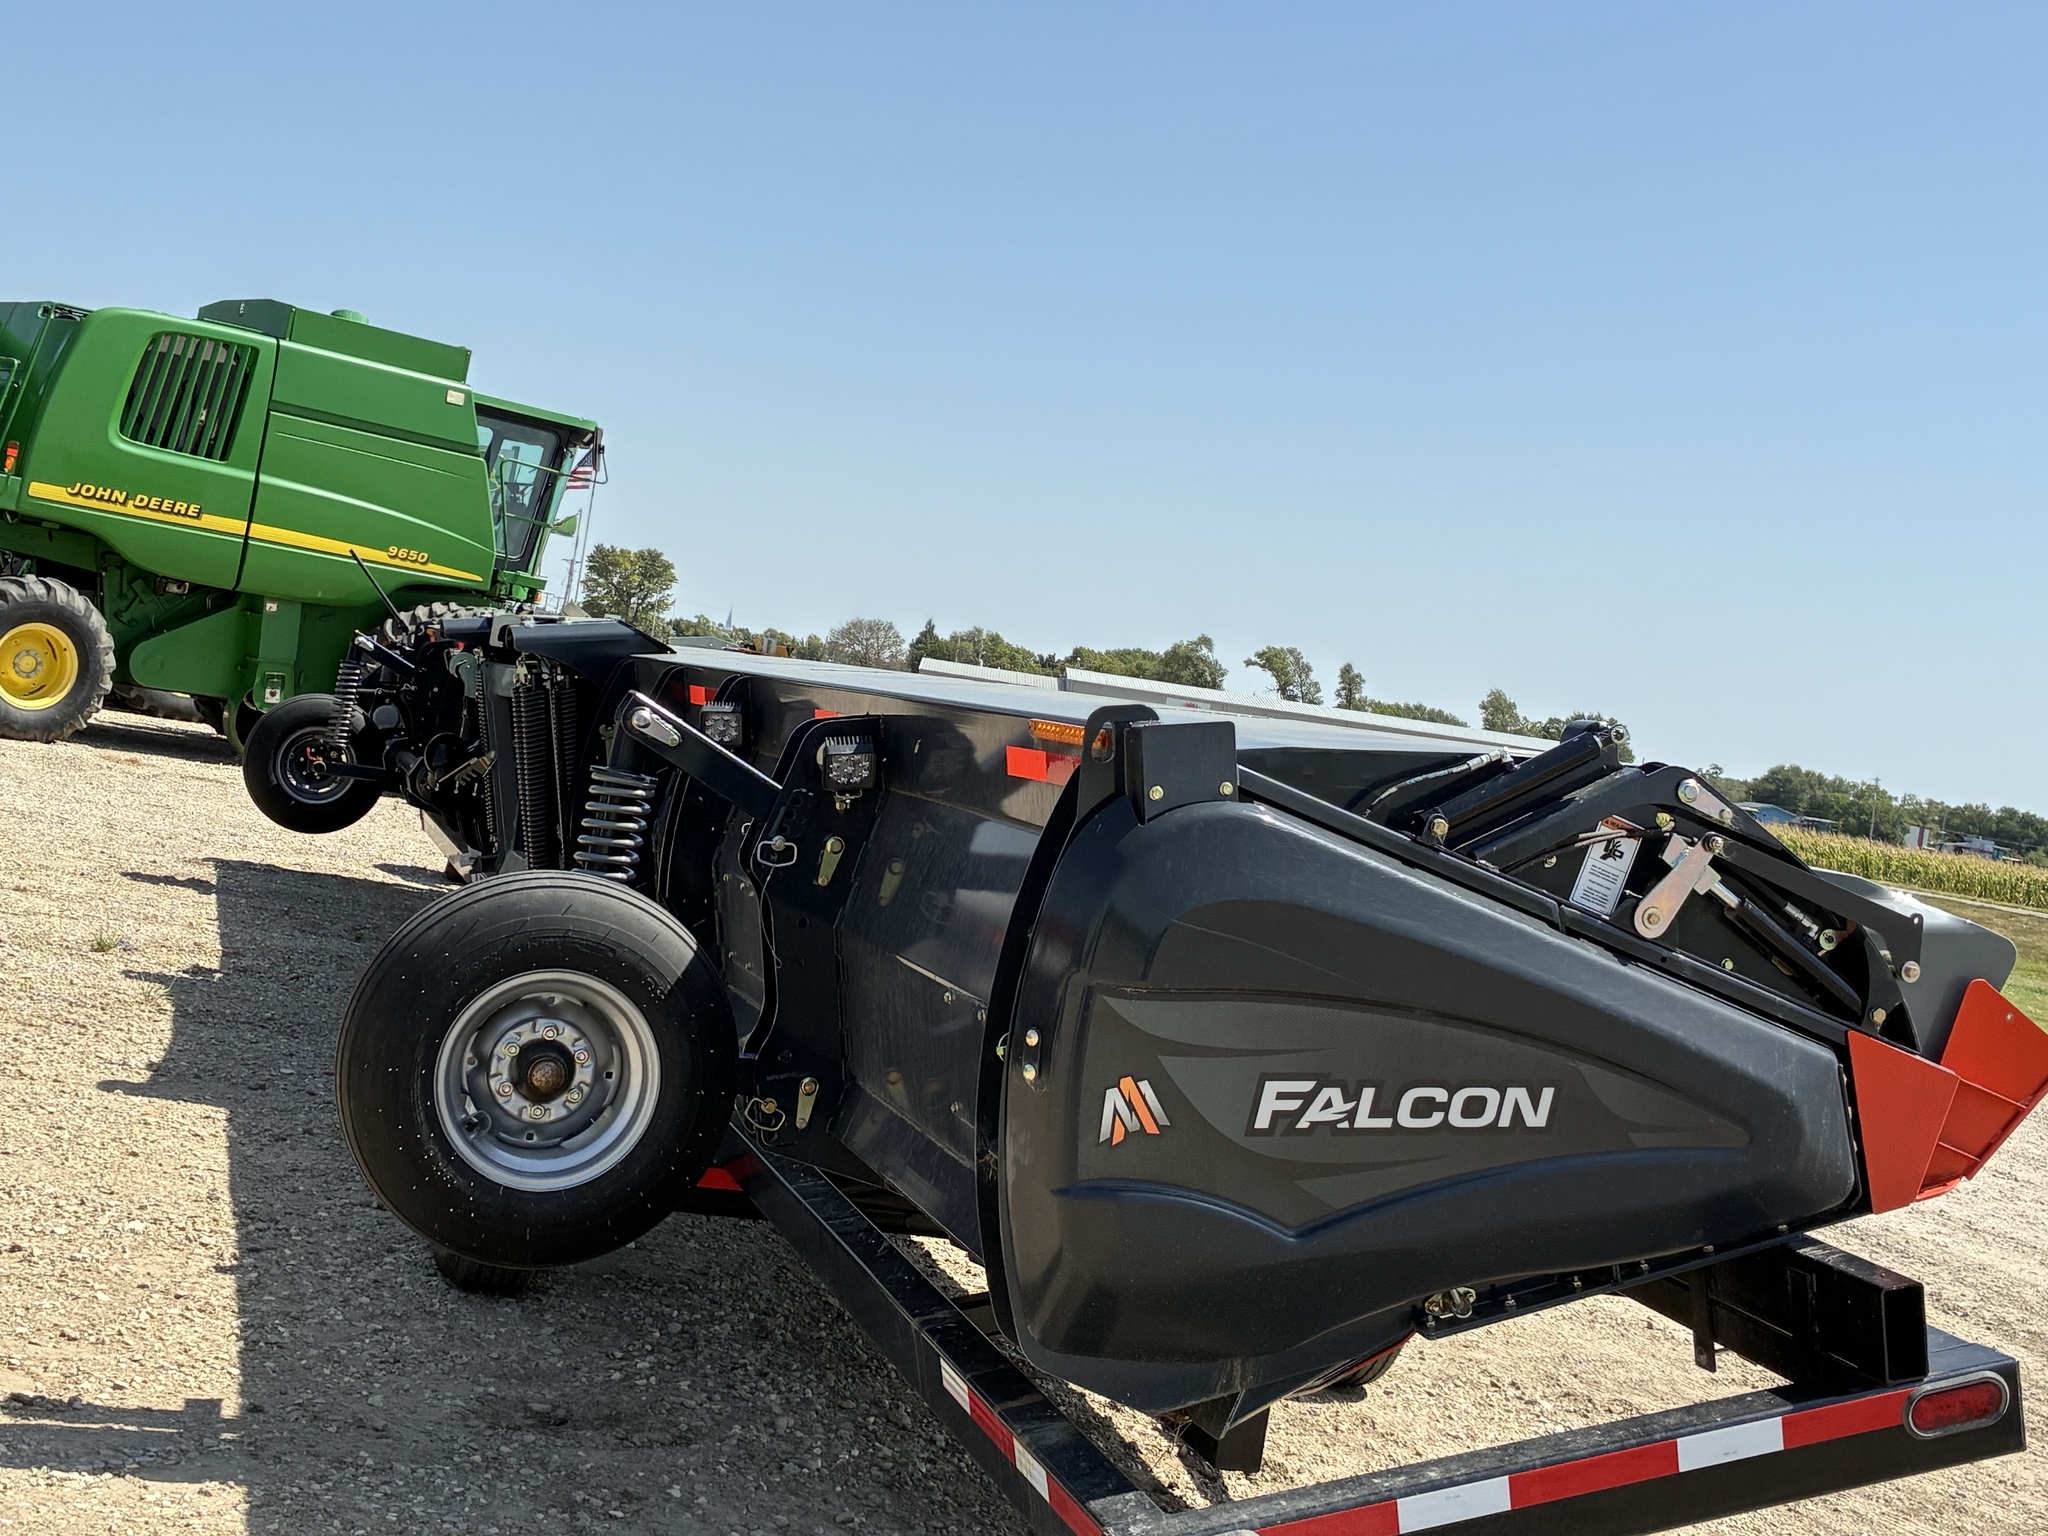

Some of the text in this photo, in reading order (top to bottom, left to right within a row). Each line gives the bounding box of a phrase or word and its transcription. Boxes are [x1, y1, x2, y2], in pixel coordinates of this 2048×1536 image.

[66, 482, 202, 518] JOHN DEERE
[387, 545, 429, 564] 9650
[1252, 1079, 1556, 1129] FALCON
